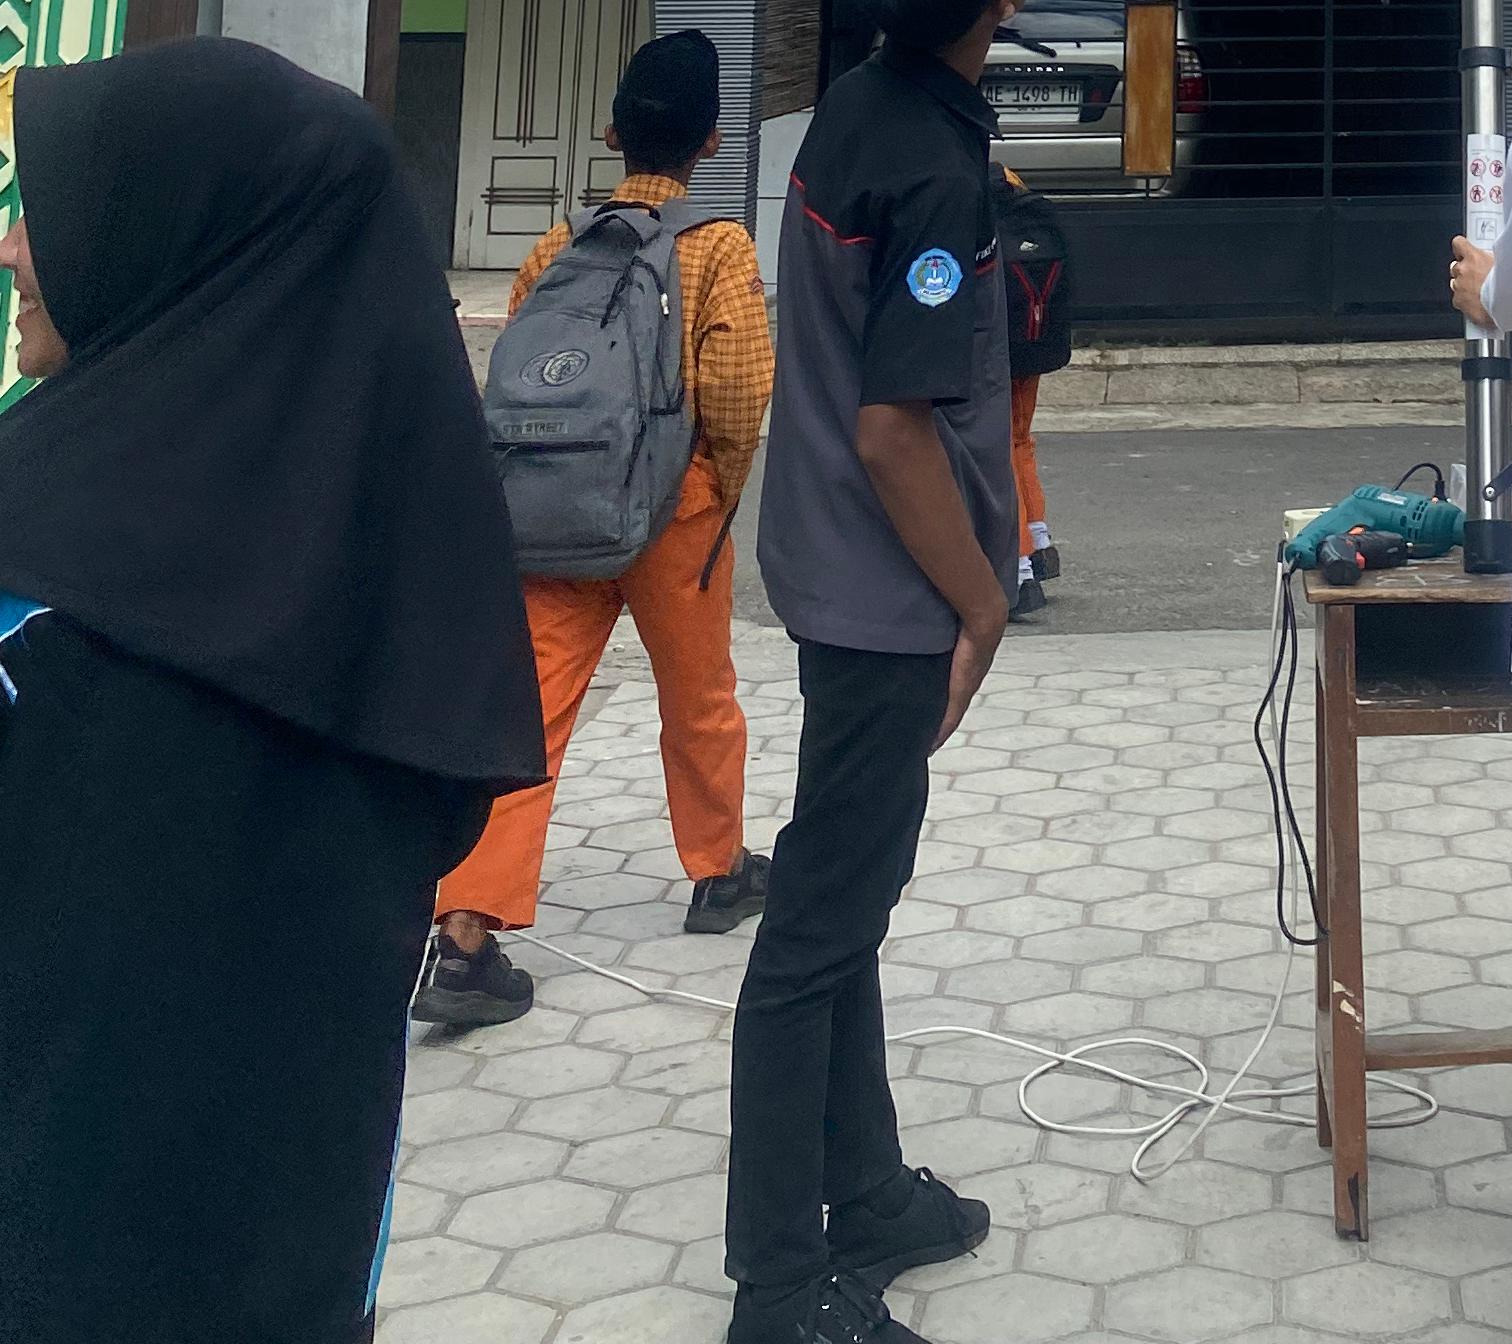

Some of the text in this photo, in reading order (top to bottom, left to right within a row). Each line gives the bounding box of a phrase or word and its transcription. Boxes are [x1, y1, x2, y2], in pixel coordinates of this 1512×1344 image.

[985, 85, 1078, 102] AE 1498 TH
